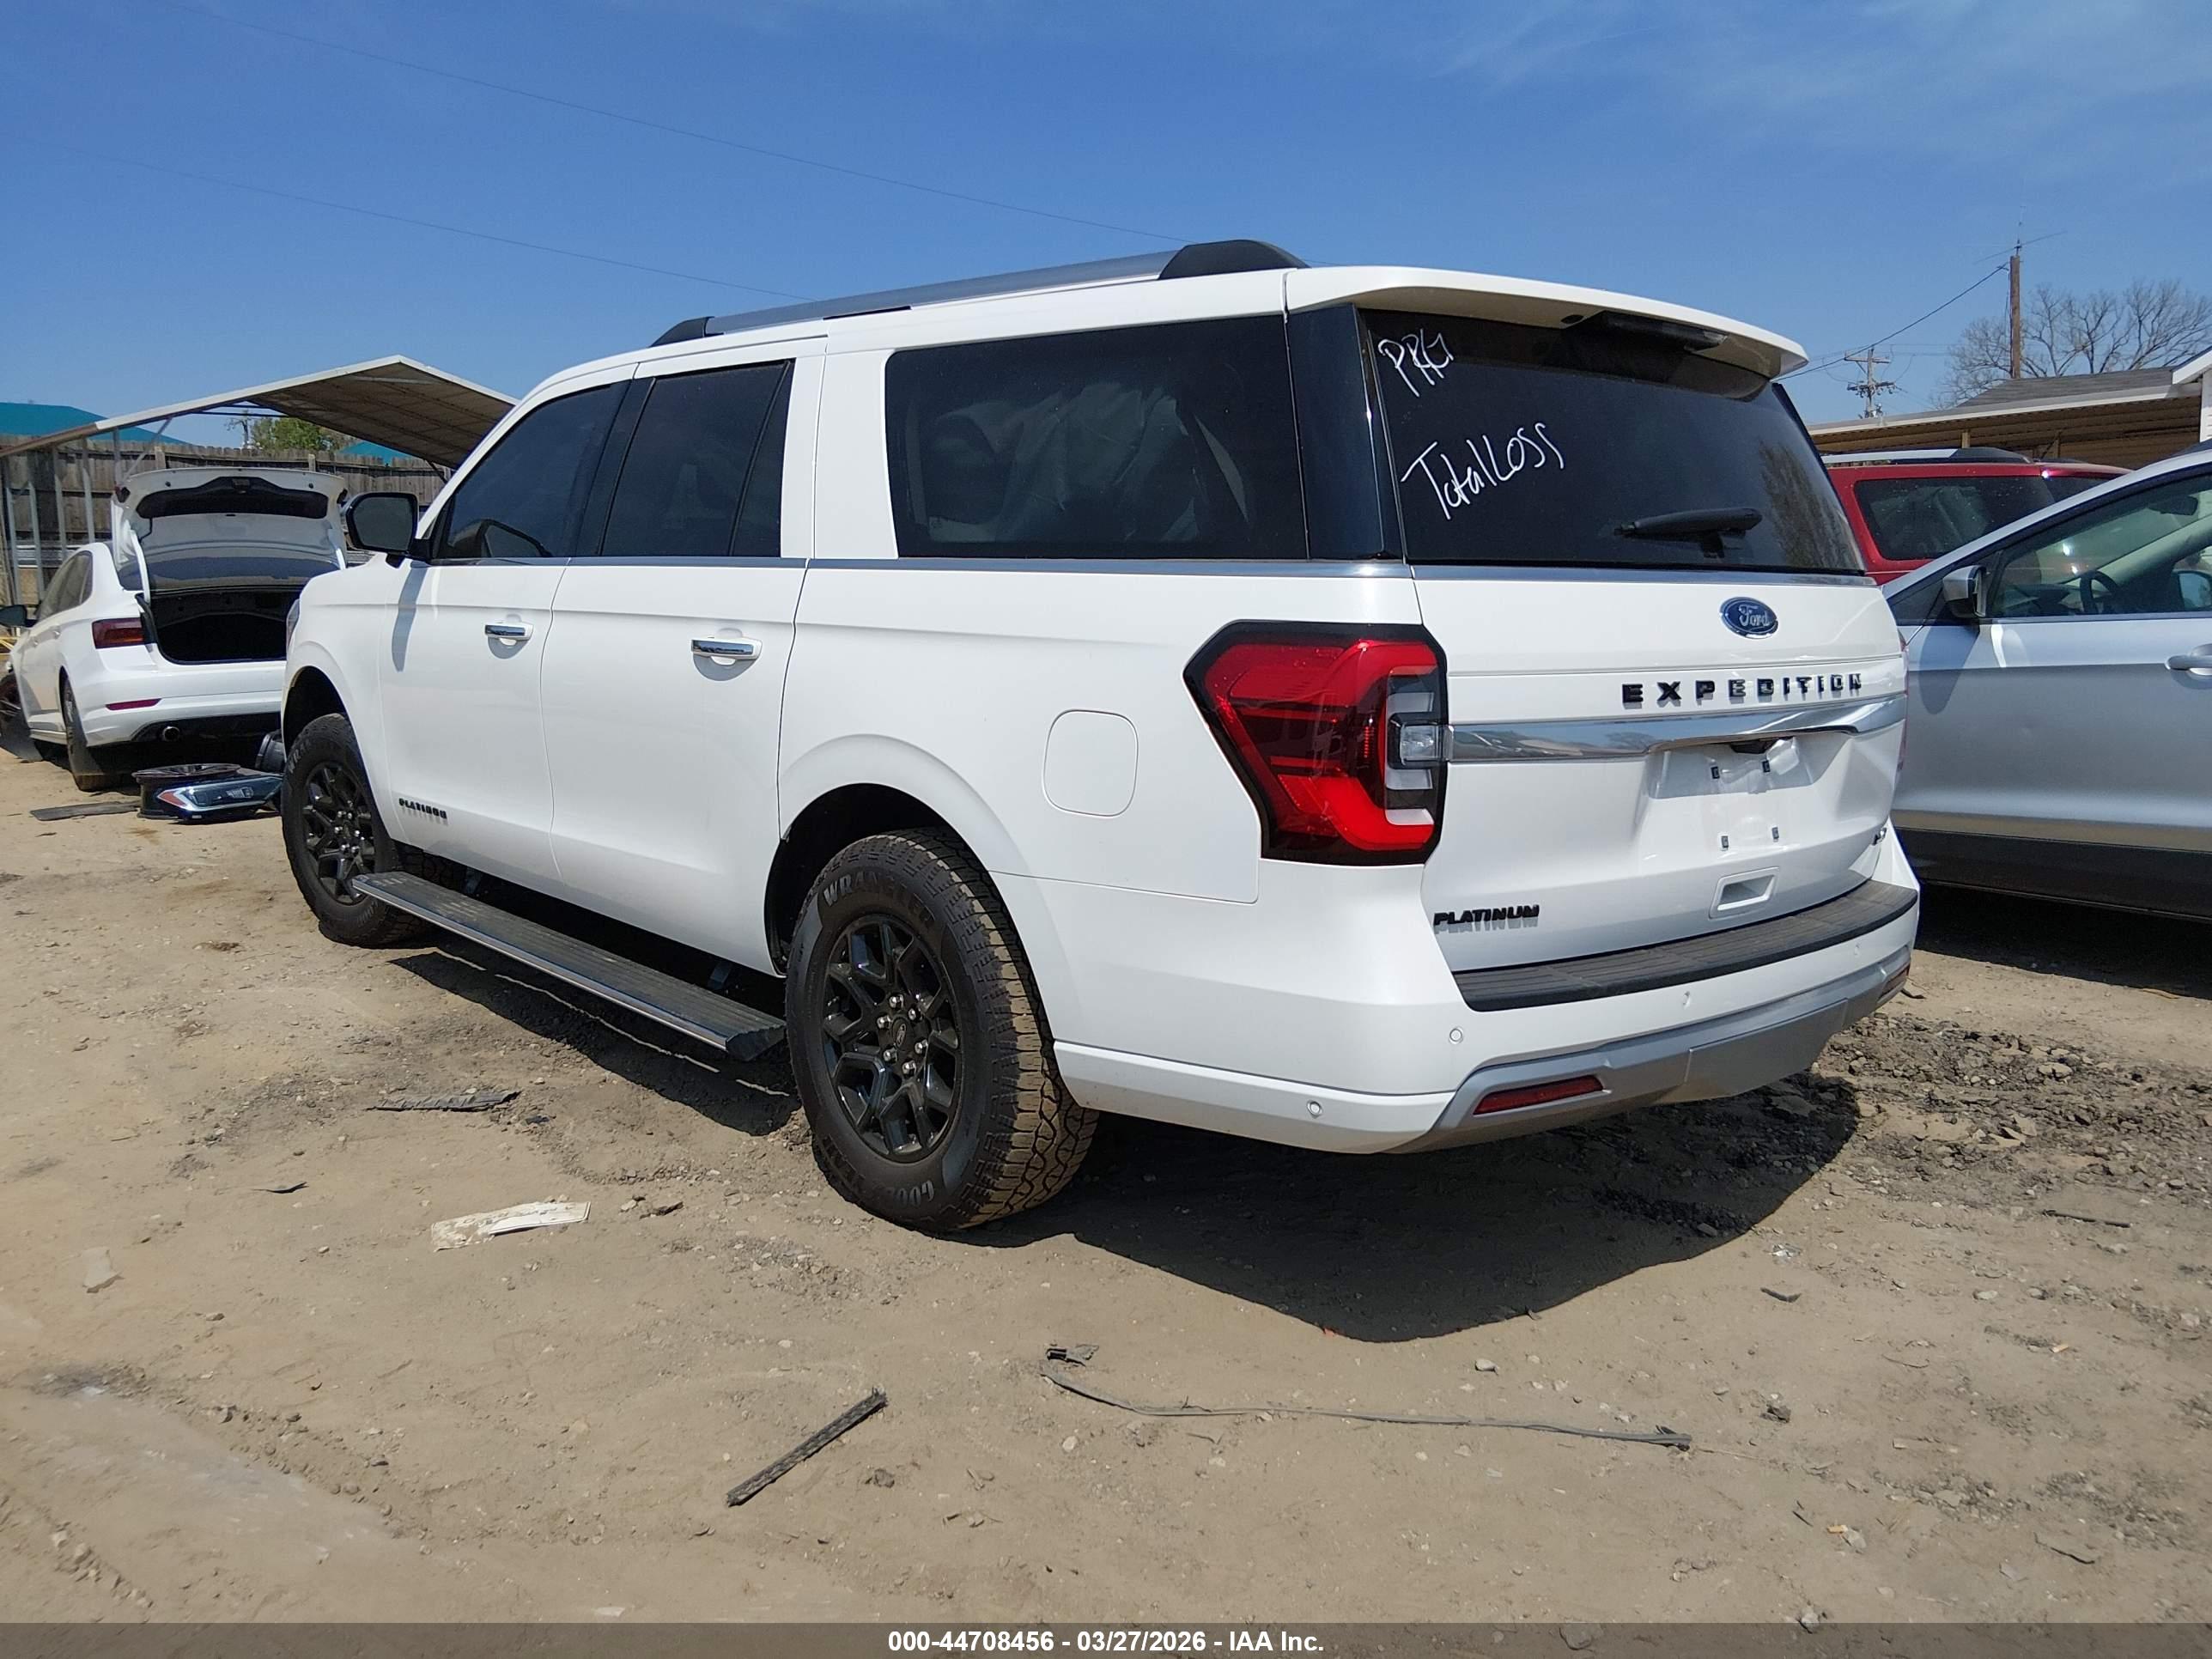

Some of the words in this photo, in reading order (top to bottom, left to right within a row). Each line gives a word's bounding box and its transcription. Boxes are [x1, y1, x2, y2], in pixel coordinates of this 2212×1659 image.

[1400, 439, 1498, 520] Total
[1621, 673, 1863, 704] EXPEDITION
[1433, 904, 1540, 927] PLATINUM
